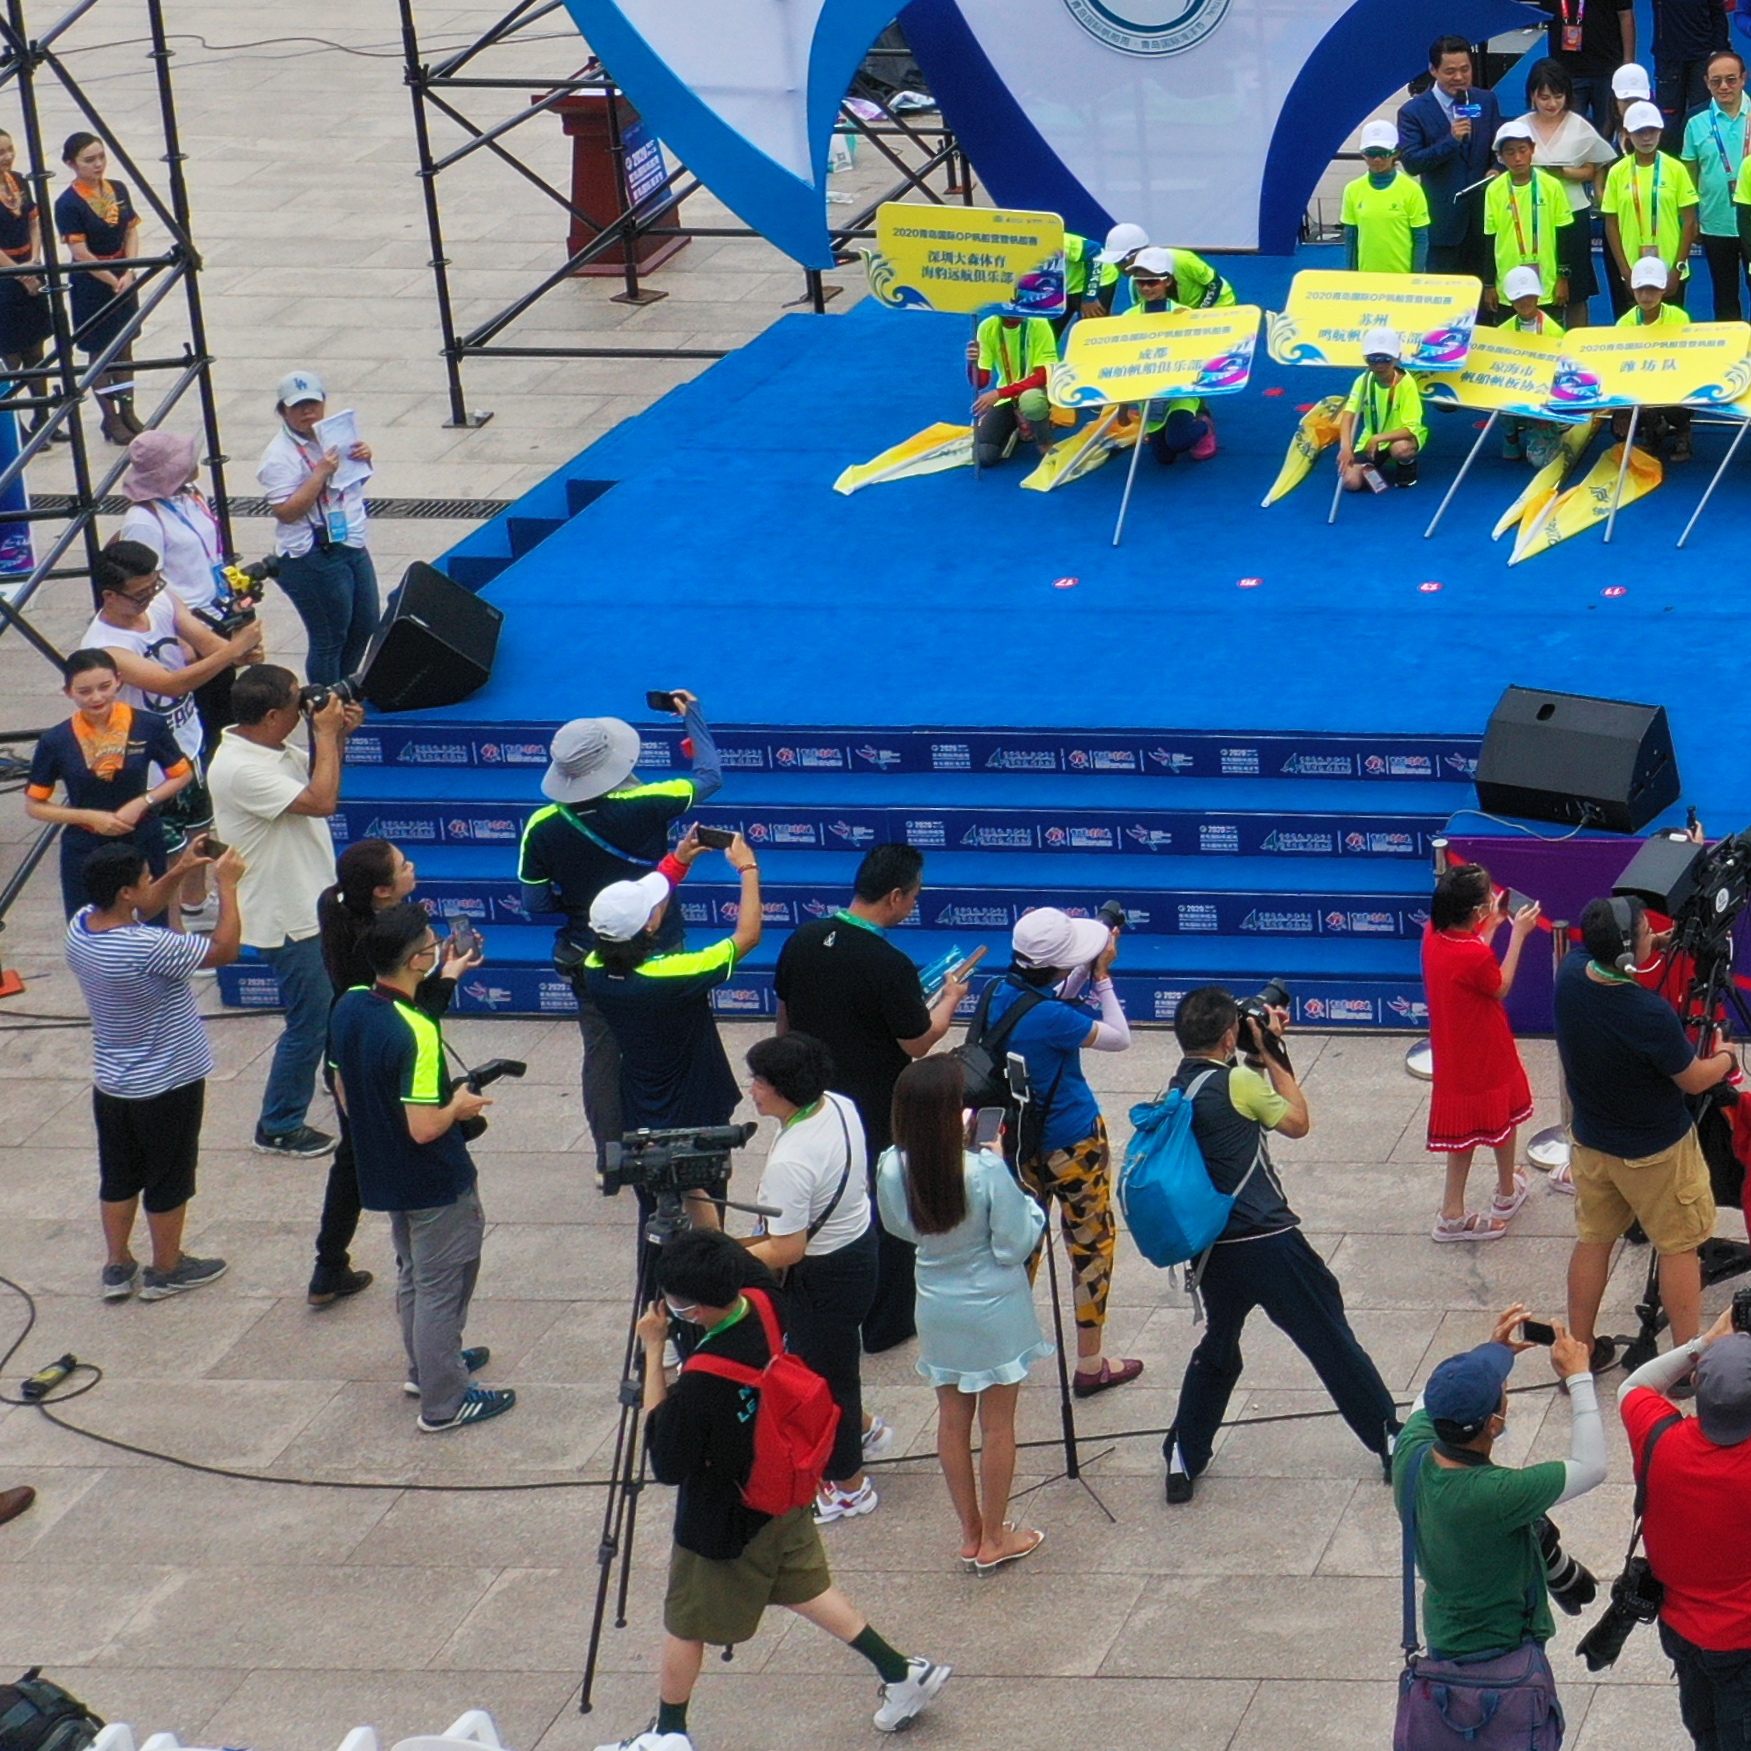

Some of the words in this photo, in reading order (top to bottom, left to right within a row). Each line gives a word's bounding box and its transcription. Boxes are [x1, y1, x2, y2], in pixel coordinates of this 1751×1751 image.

[1357, 311, 1389, 328] 苏州
[1138, 346, 1168, 362] 成都
[1619, 356, 1677, 374] 潍坊队
